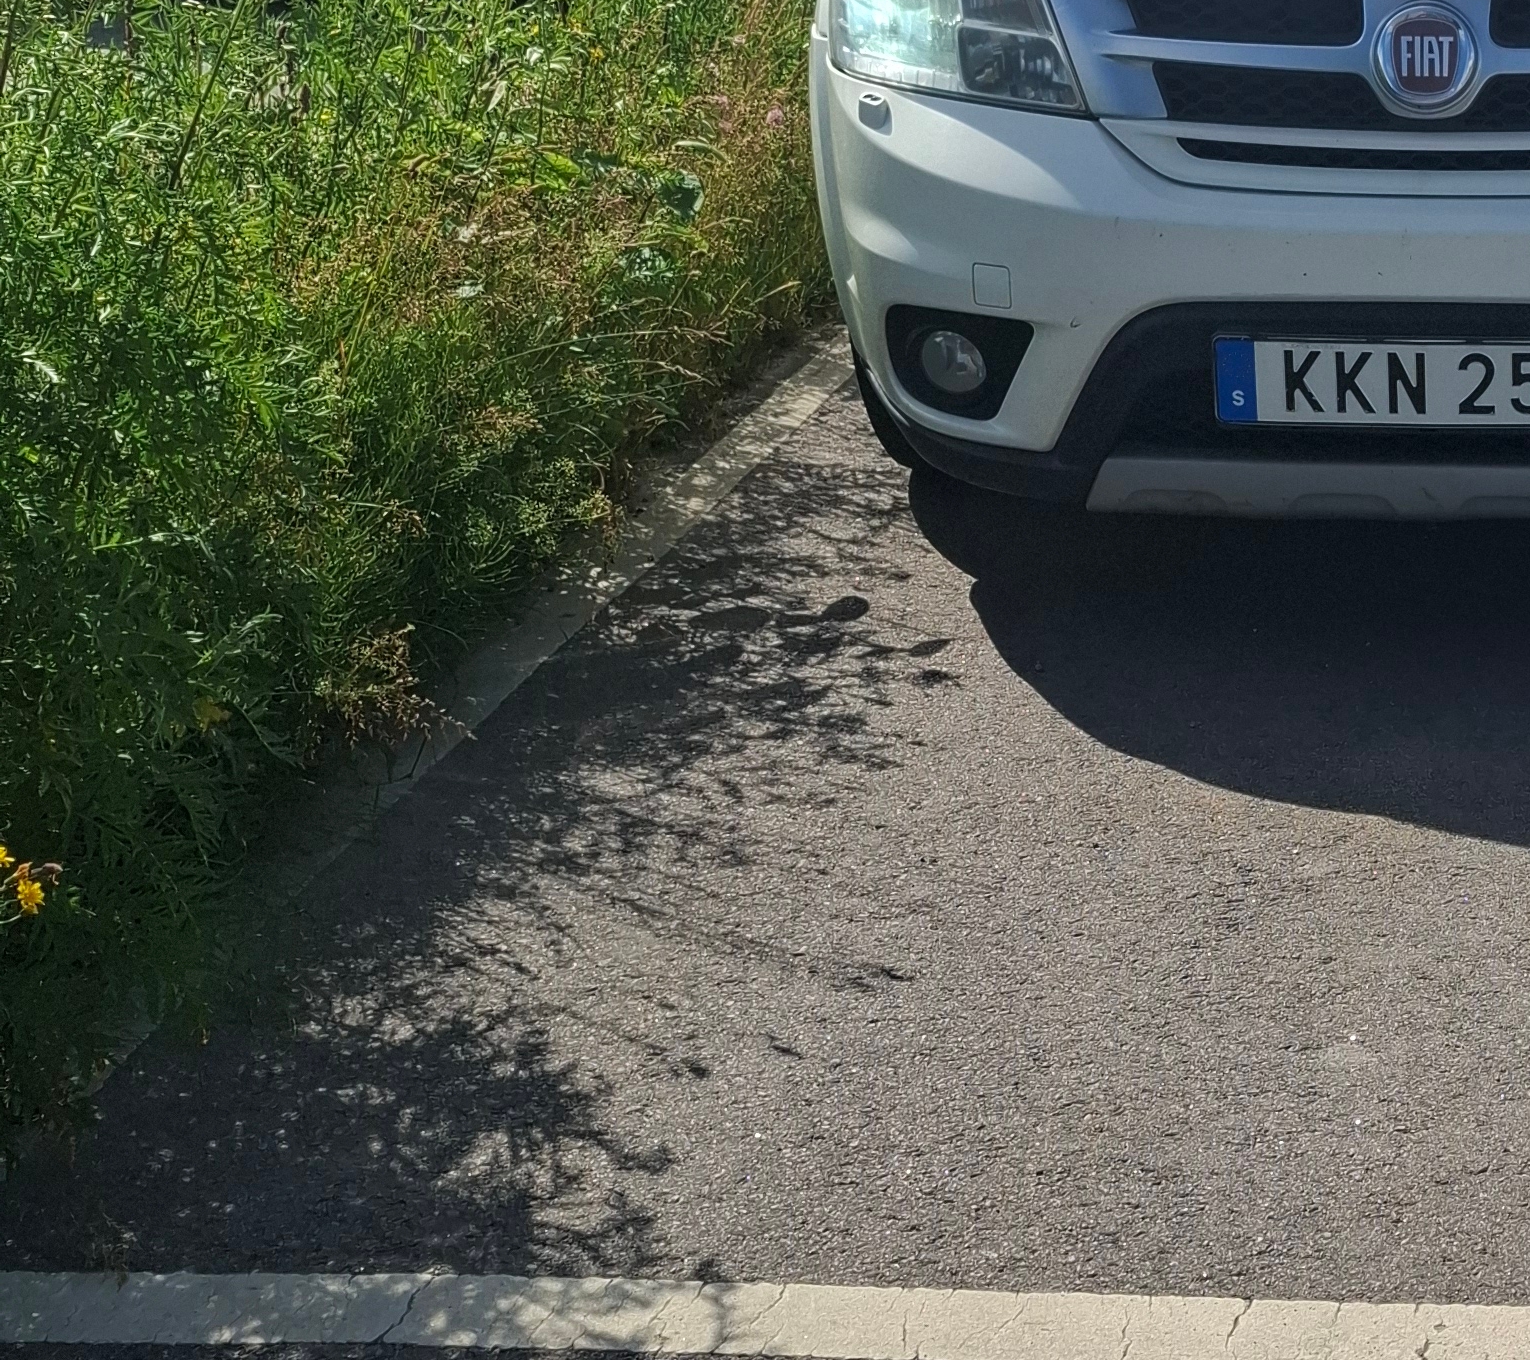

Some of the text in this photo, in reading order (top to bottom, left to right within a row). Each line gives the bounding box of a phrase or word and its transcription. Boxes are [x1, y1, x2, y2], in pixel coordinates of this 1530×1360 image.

[1400, 36, 1454, 77] FIAT
[1231, 389, 1245, 407] S
[1283, 349, 1427, 415] KKN
